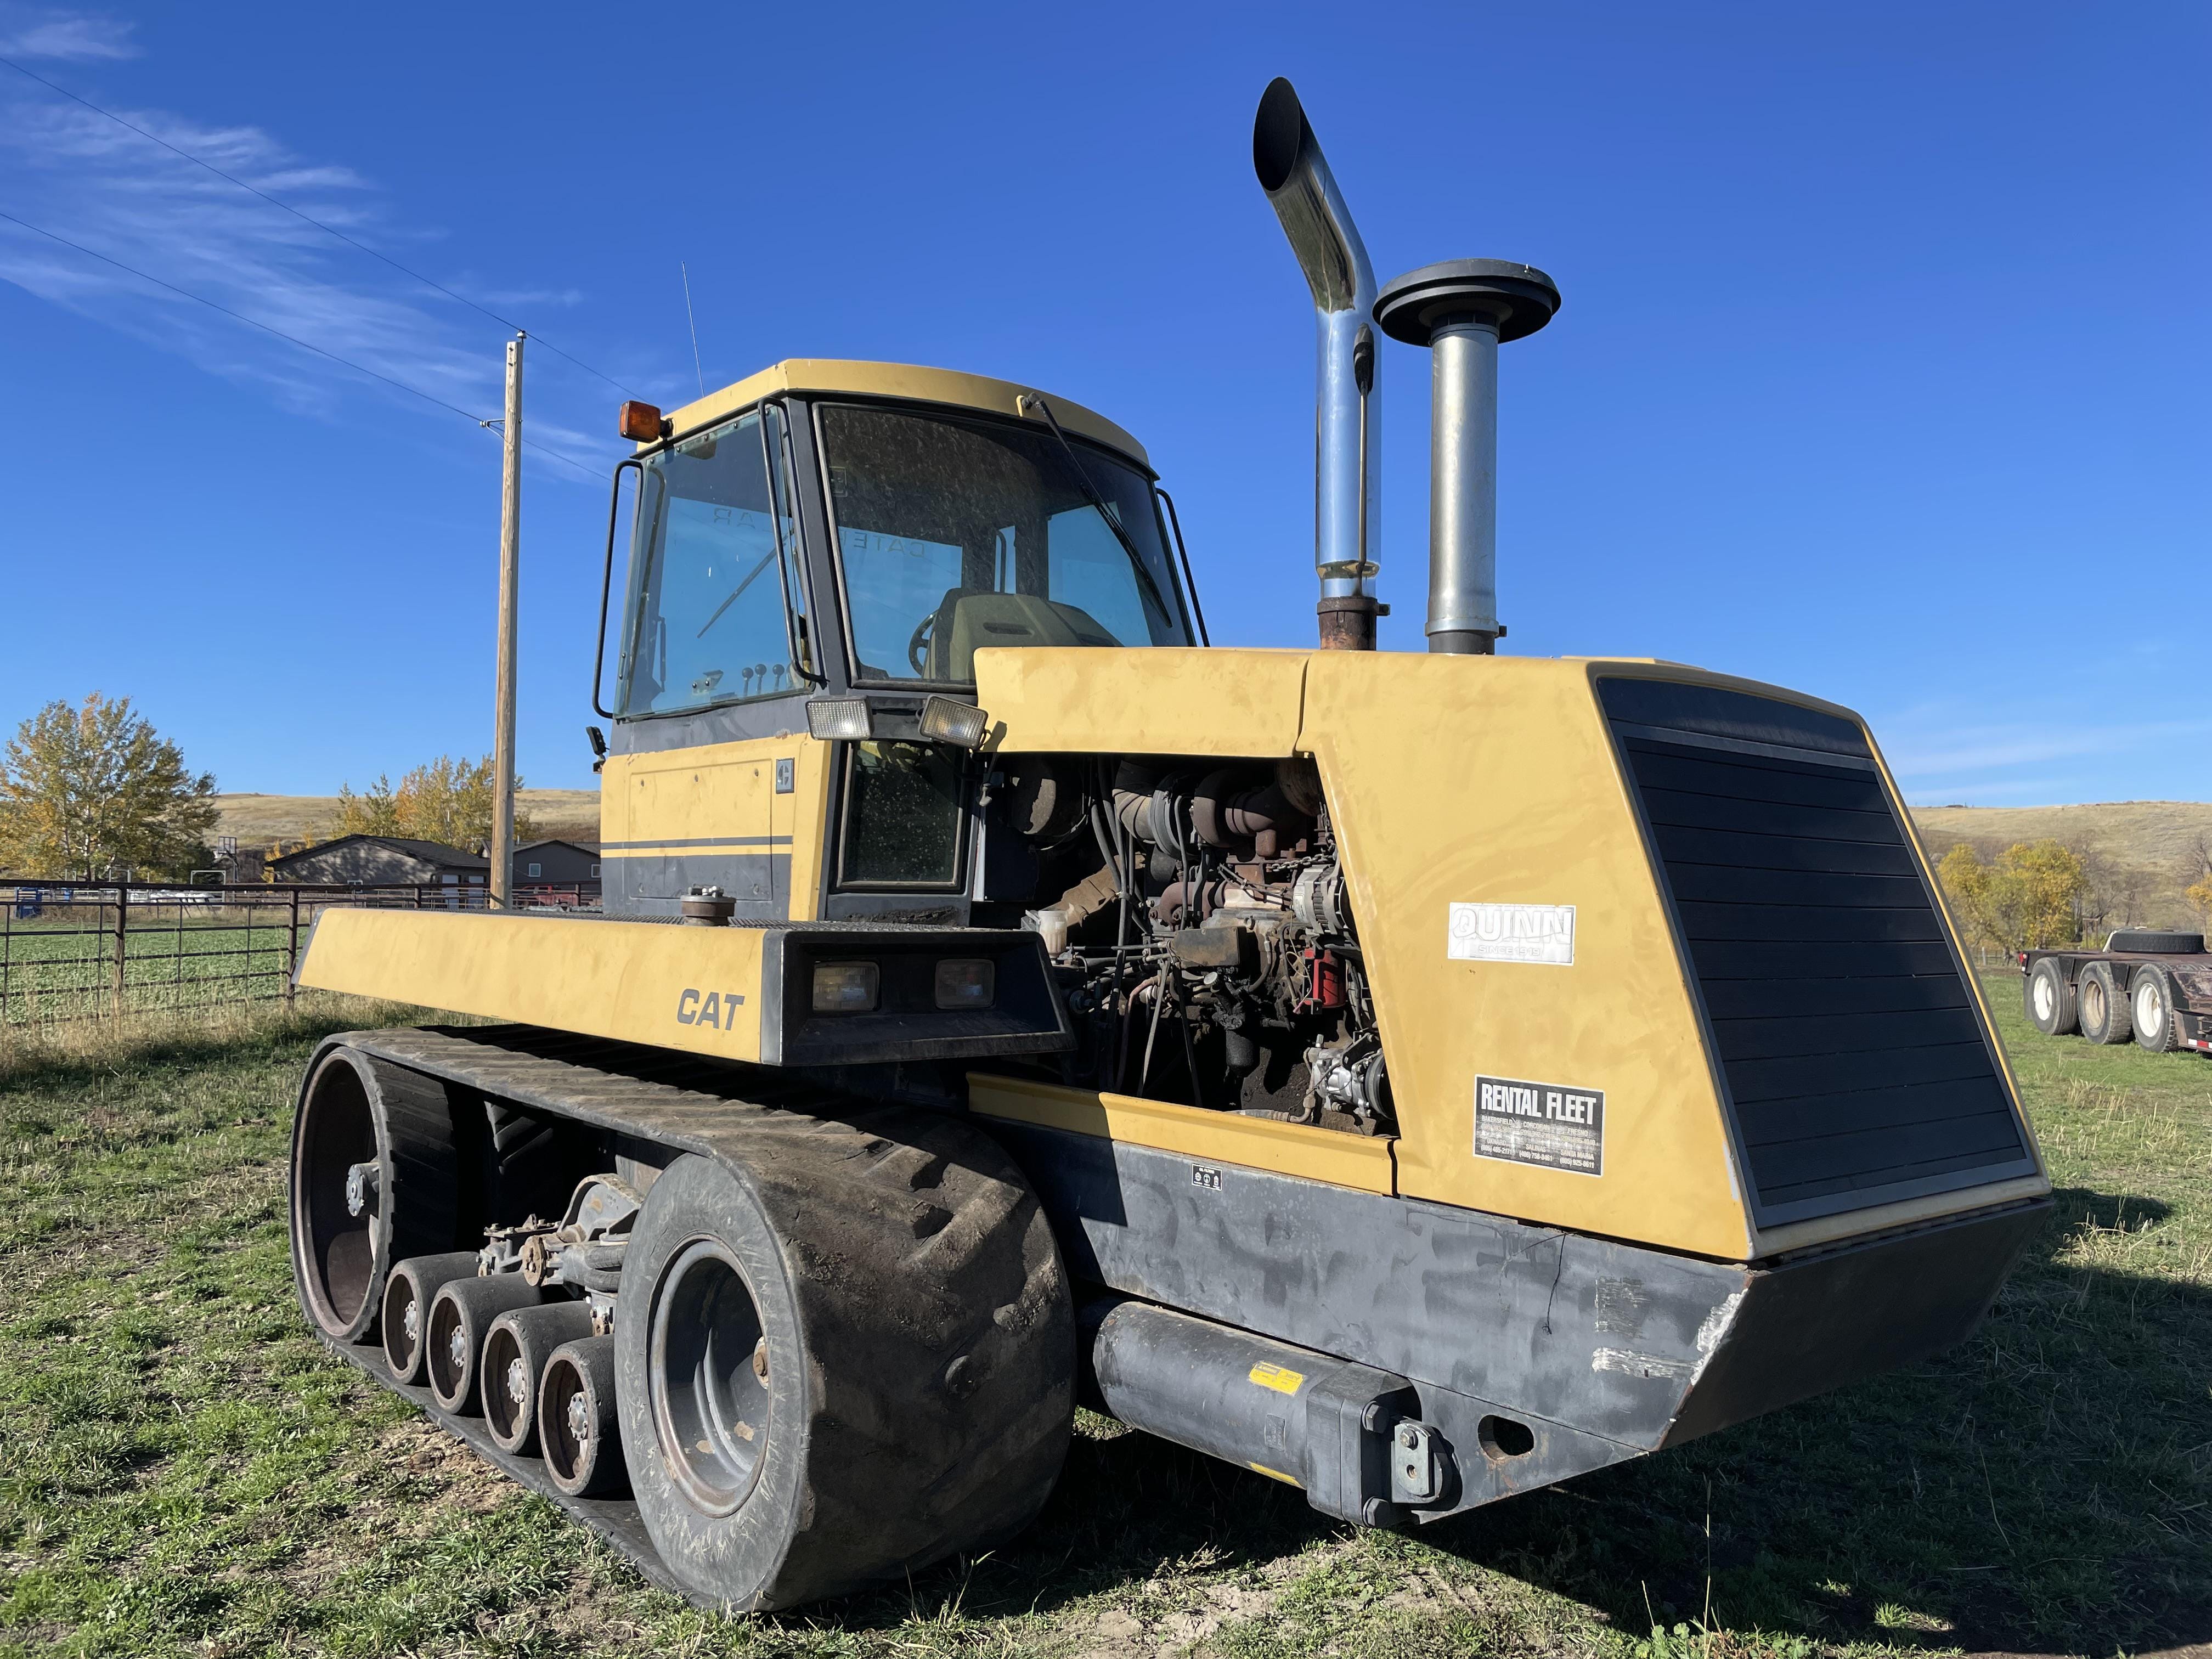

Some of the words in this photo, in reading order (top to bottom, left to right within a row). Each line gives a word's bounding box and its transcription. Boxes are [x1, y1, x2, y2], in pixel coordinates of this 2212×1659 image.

[1453, 908, 1571, 944] QUINN
[1478, 945, 1513, 955] SINCE
[1514, 946, 1541, 956] 1919
[677, 988, 746, 1031] CAT
[1481, 1083, 1542, 1118] RENTAL
[1546, 1092, 1596, 1125] FLEET
[1482, 1115, 1513, 1125] BAKERSFIELD
[1567, 1127, 1588, 1137] FRESNO
[1525, 1143, 1546, 1153] SALINAS
[1560, 1149, 1577, 1158] SANTA
[1577, 1151, 1594, 1160] MARIA
